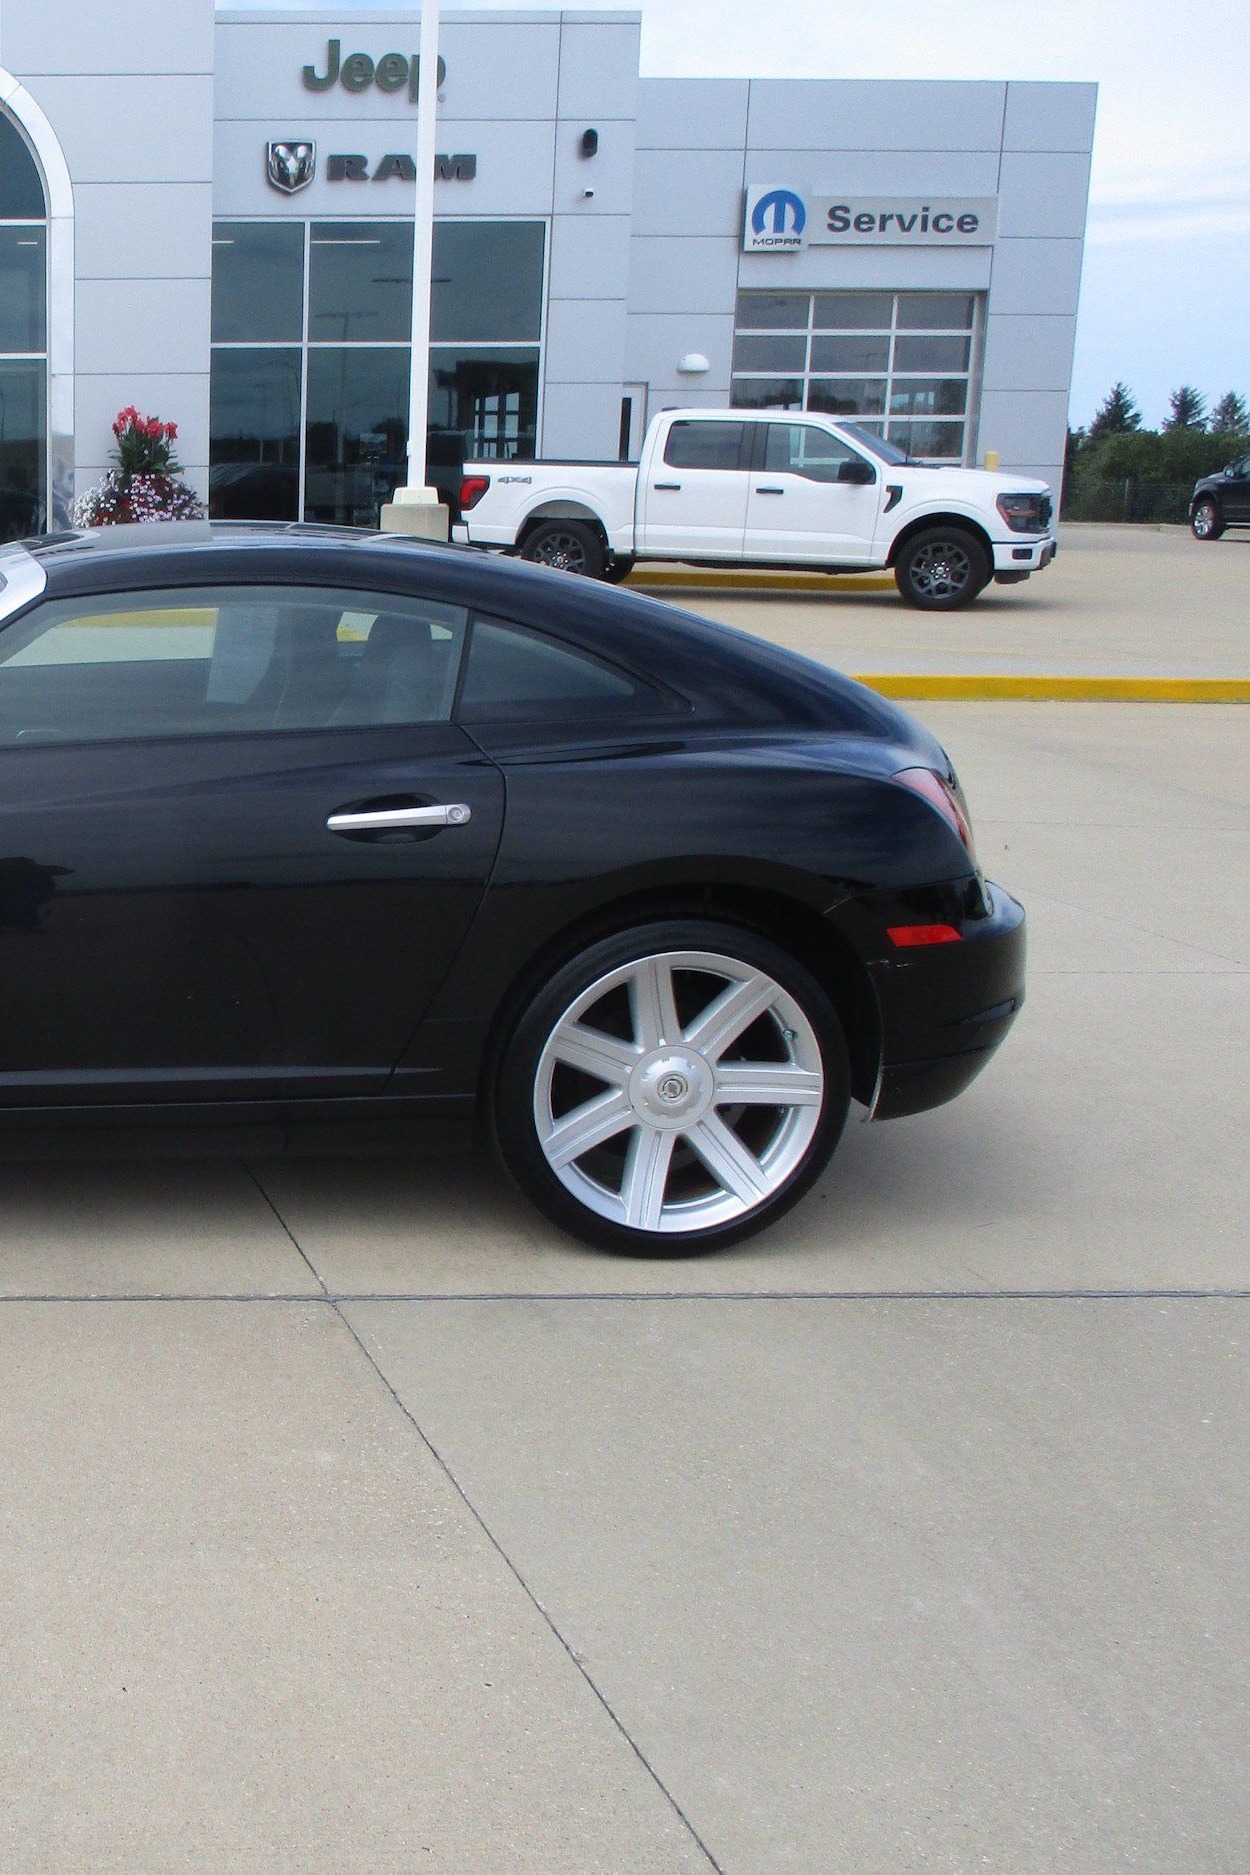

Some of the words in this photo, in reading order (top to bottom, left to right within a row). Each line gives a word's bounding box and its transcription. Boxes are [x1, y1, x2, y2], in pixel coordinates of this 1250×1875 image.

[327, 154, 477, 180] RAM
[827, 205, 979, 233] Service
[753, 238, 802, 246] MOPAR
